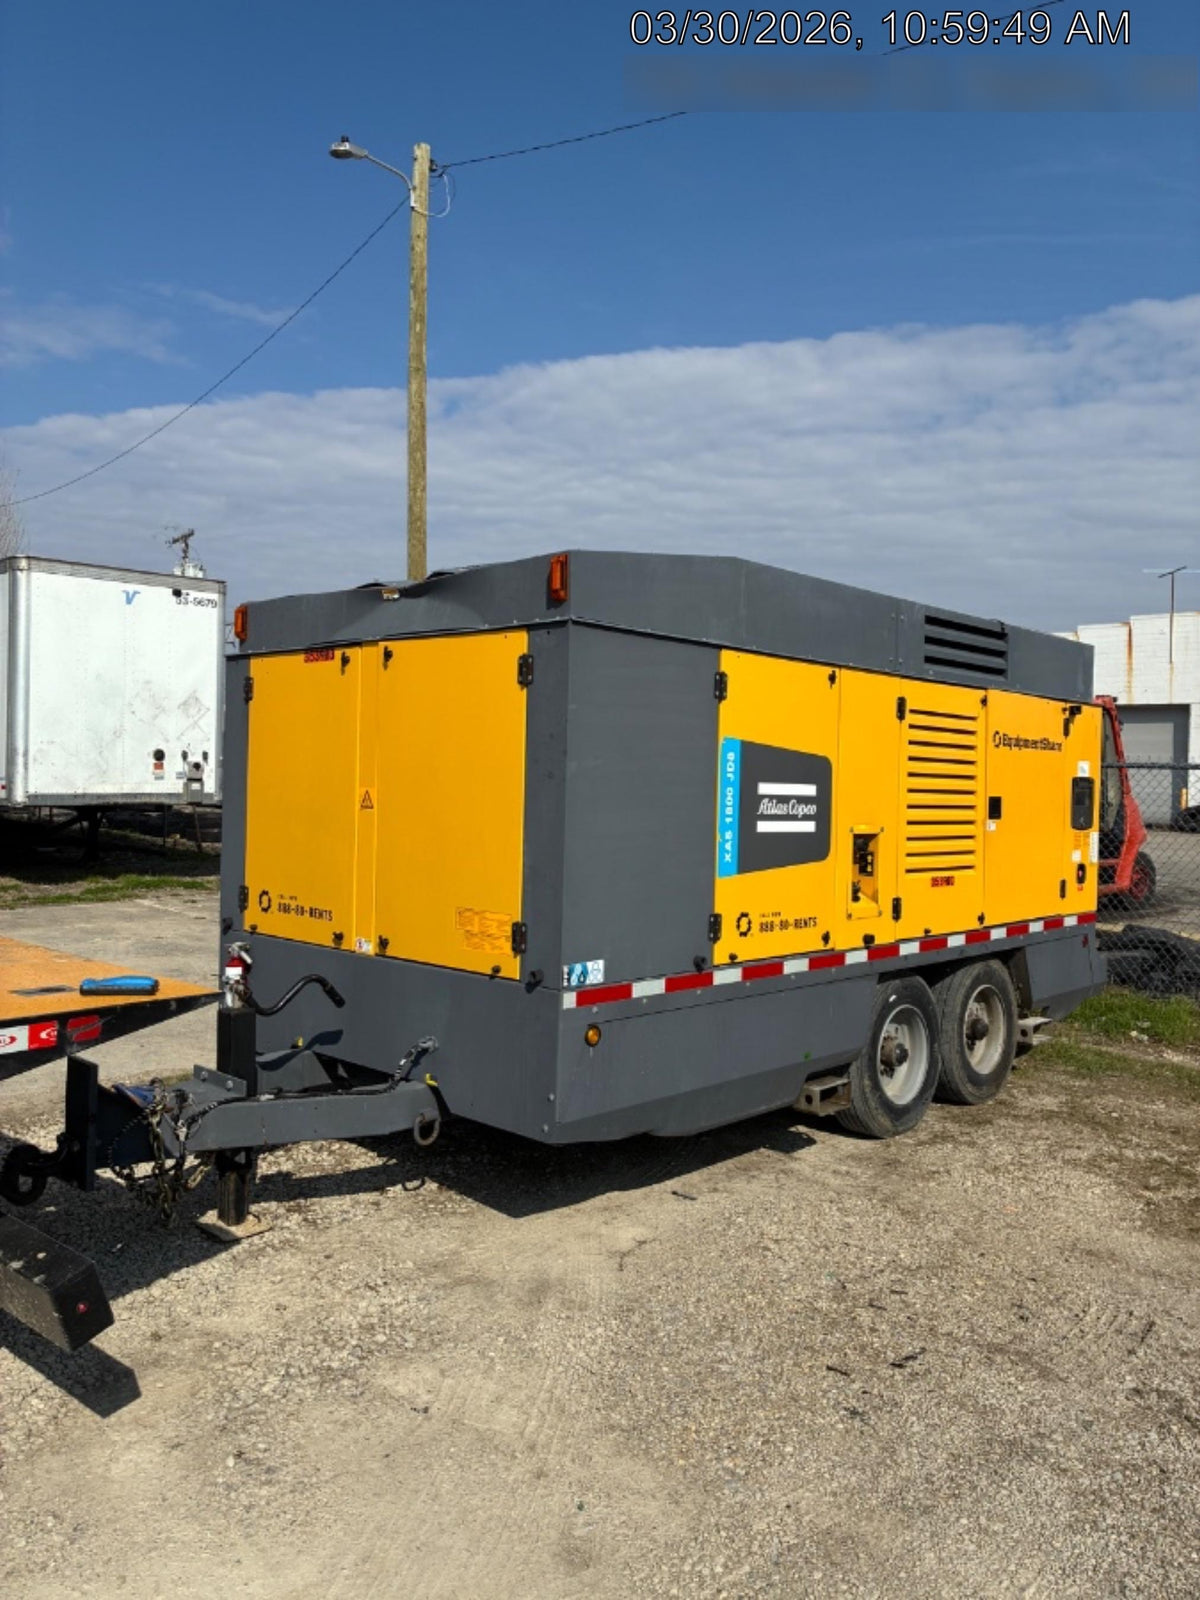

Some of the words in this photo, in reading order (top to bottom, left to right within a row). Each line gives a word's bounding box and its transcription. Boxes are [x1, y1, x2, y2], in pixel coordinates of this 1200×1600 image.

[725, 787, 734, 824] 1800
[757, 798, 788, 815] Atlas
[788, 798, 817, 818] Copco
[724, 830, 733, 862] XAS
